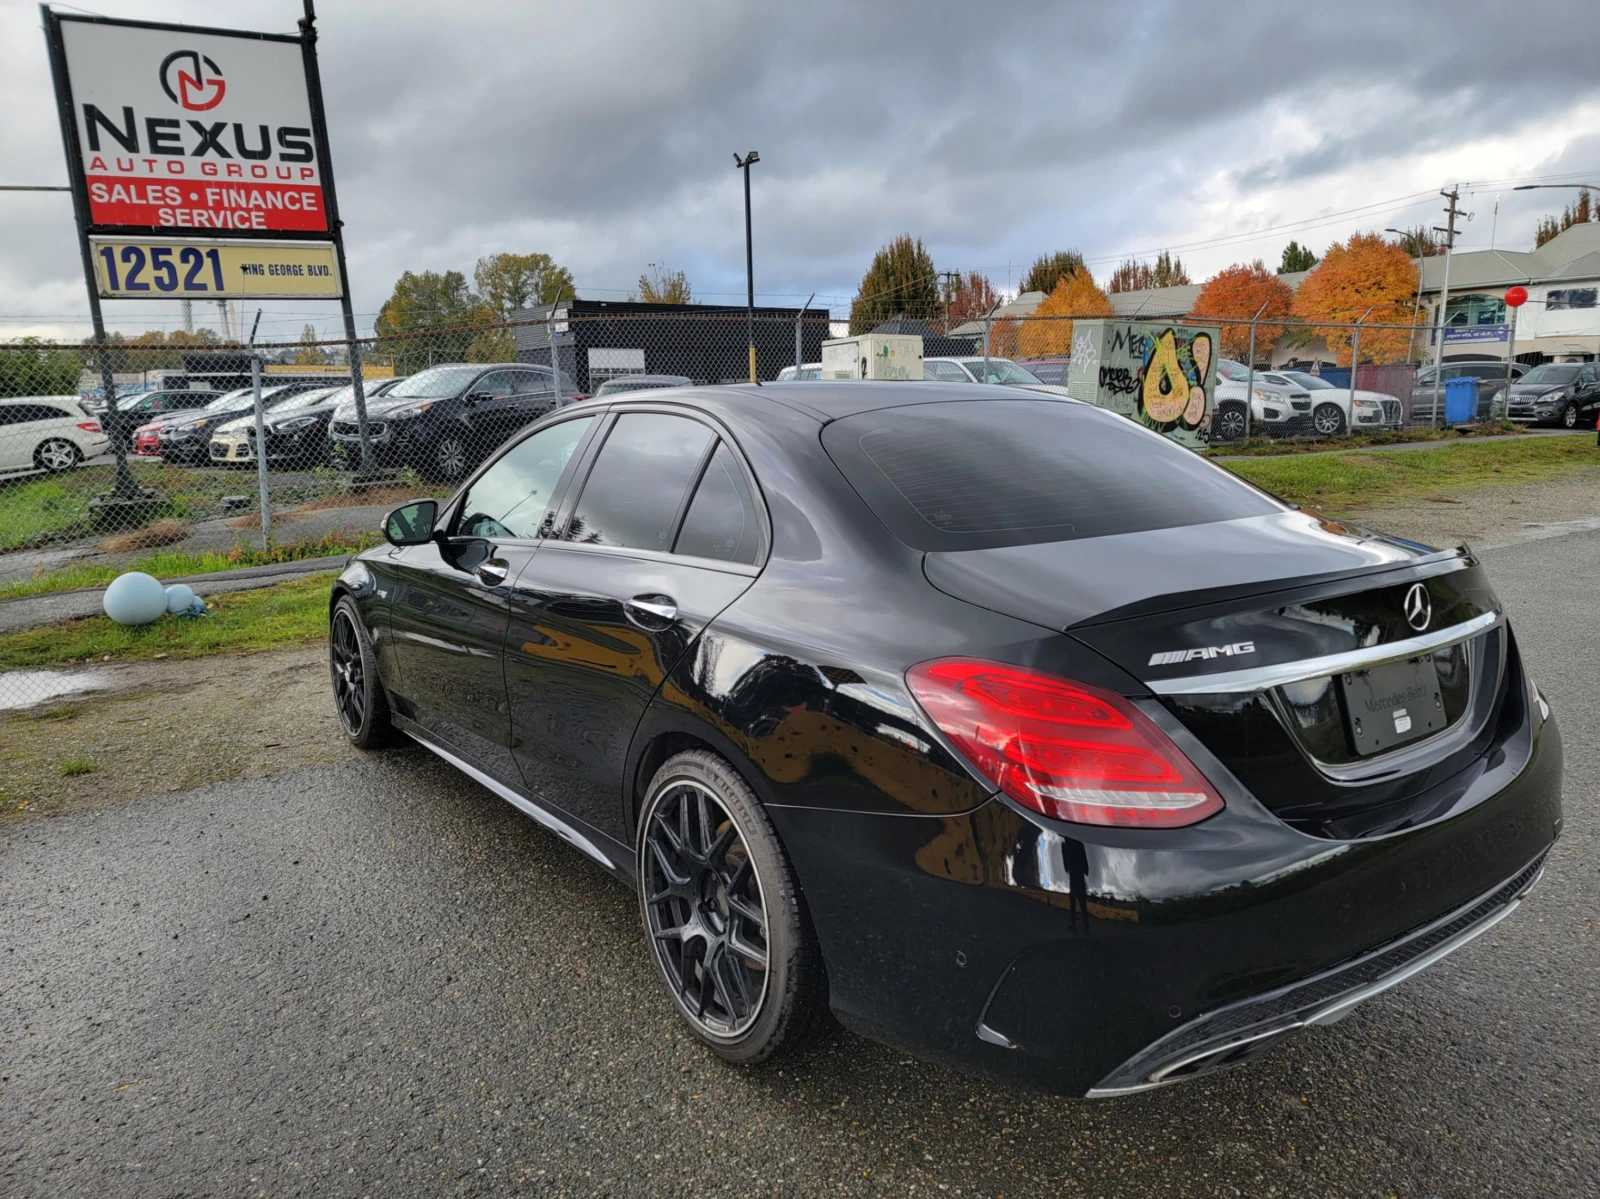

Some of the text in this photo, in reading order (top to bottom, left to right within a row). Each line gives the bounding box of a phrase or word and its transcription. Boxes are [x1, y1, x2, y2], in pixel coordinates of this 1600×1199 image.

[82, 103, 314, 163] NEXUS
[90, 156, 315, 181] AUTO GROUP
[91, 183, 318, 211] SALES FINANCE
[158, 208, 267, 229] SERVICE
[100, 246, 225, 292] 12521
[268, 264, 304, 276] GEORGE
[1364, 685, 1428, 713] Mercedes-Benz
